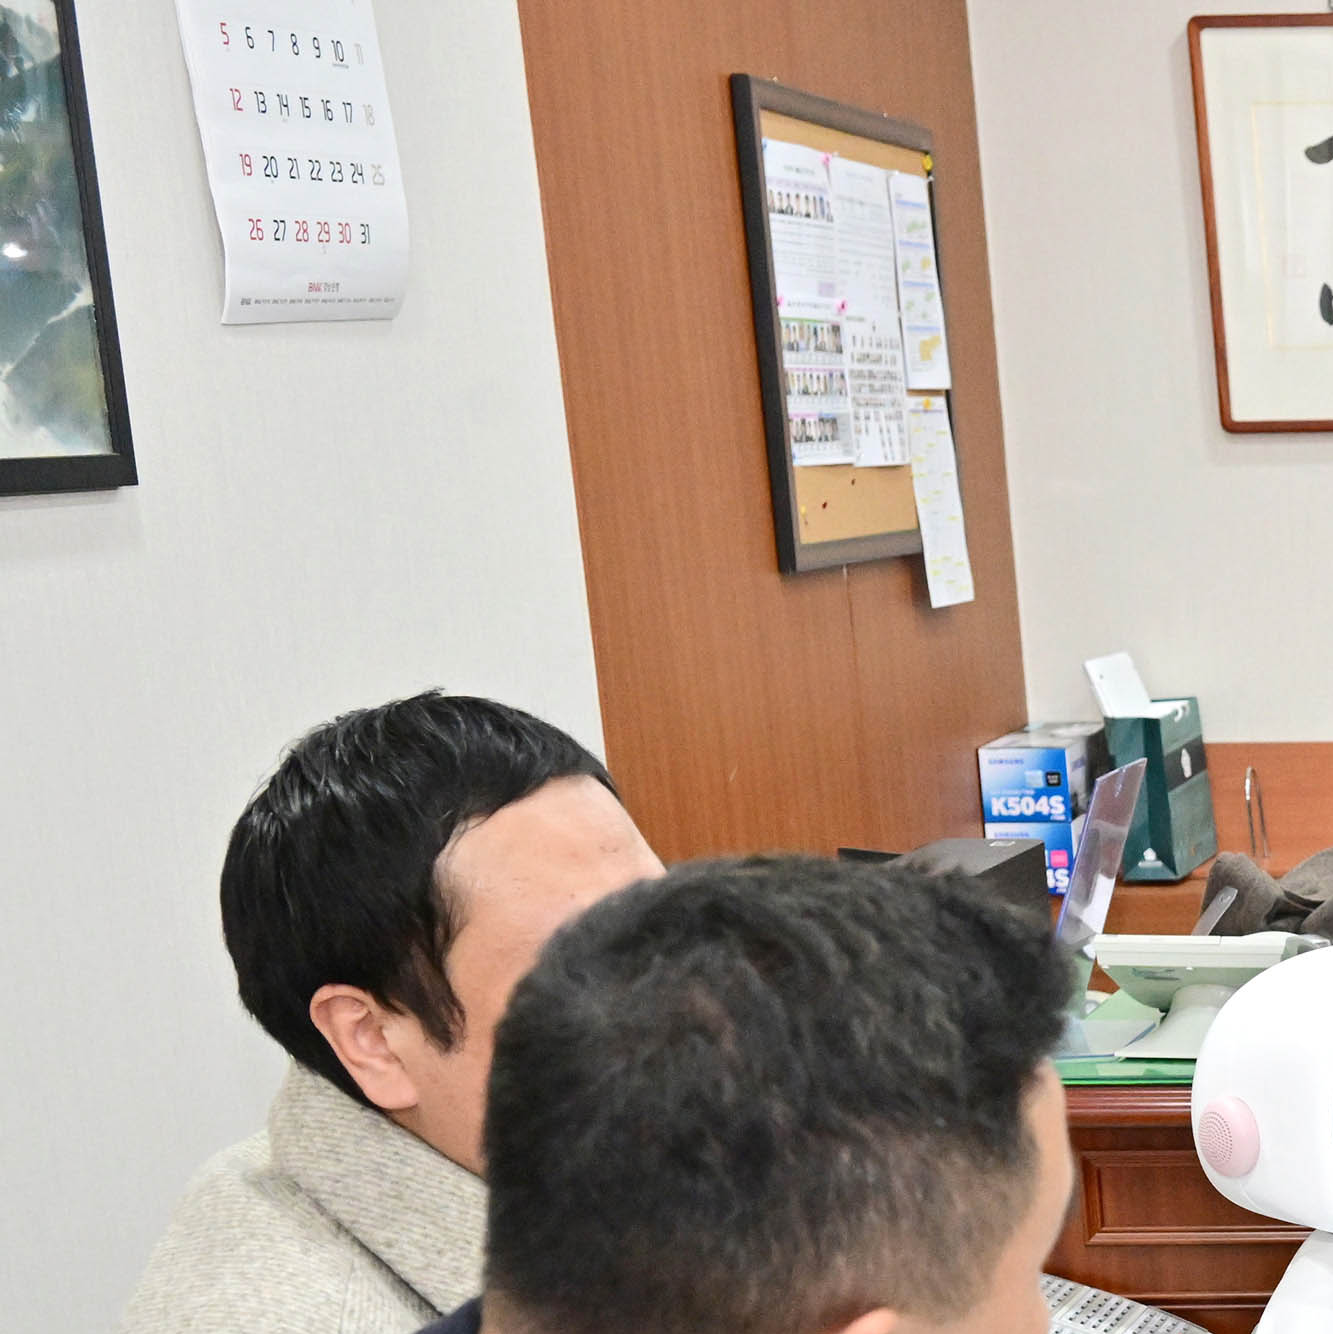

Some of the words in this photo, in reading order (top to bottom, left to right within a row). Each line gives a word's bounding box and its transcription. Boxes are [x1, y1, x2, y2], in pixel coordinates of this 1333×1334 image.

[220, 22, 230, 45] 5
[245, 26, 255, 49] 6
[267, 30, 276, 52] 7
[290, 33, 300, 56] 8
[312, 36, 321, 59] 9
[331, 40, 345, 62] 10
[229, 88, 243, 111] 12
[254, 91, 267, 114] 13
[276, 93, 290, 117] 14
[299, 96, 311, 119] 15
[321, 99, 333, 121] 16
[342, 102, 353, 123] 17
[240, 153, 253, 176] 19
[262, 156, 278, 178] 20
[287, 157, 300, 180] 21
[308, 159, 323, 182] 22
[329, 161, 344, 183] 23
[350, 163, 364, 184] 24
[248, 218, 264, 241] 26
[273, 219, 286, 241] 27
[295, 220, 309, 243] 28
[316, 221, 331, 243] 29
[338, 222, 352, 244] 30
[360, 223, 370, 244] 31
[991, 795, 1066, 817] K504S
